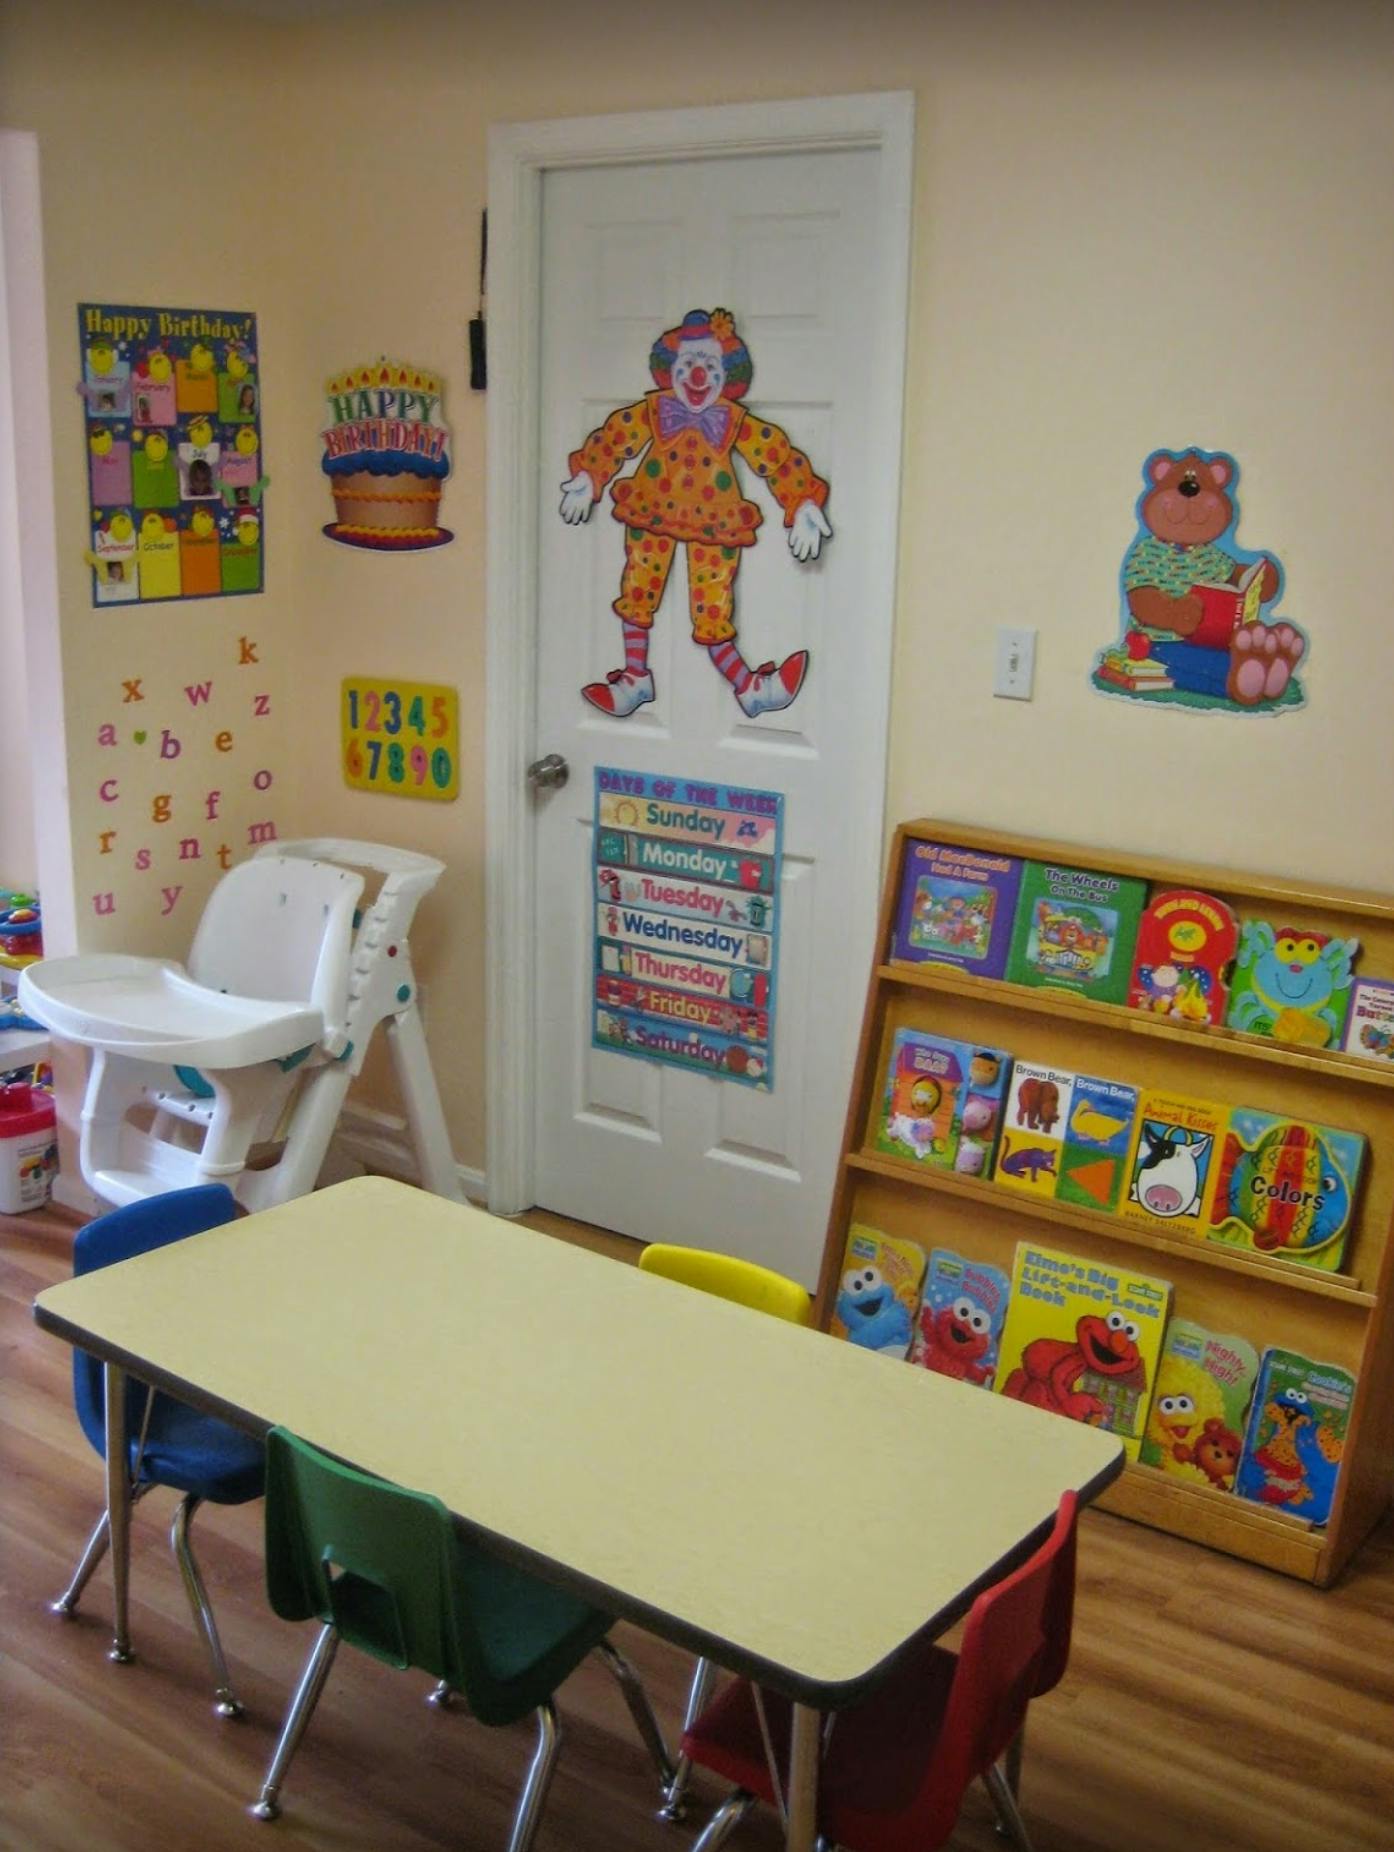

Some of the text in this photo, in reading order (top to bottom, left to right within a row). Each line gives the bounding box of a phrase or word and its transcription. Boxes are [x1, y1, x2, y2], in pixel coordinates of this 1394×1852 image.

[85, 309, 252, 340] Happy Birthday!
[329, 389, 440, 423] HAPPY
[323, 419, 447, 462] BIRTHDAY!
[238, 636, 259, 665] k
[121, 678, 145, 703] x
[184, 680, 213, 706] w
[254, 694, 270, 716] z
[97, 722, 117, 747] a
[160, 730, 181, 759] b
[215, 729, 233, 752] e
[99, 779, 119, 801] c
[253, 769, 273, 790] o
[205, 791, 221, 820] f
[600, 771, 778, 815] DAYS OF THE WEEK
[152, 793, 173, 823] g
[646, 803, 726, 838] Sunday
[99, 829, 117, 854] r
[247, 820, 277, 845] m
[135, 848, 151, 871] s
[179, 837, 202, 859] n
[217, 843, 233, 870] t
[643, 842, 727, 880] Monday
[915, 846, 938, 861] Old
[931, 862, 988, 882] Had A Farm
[1045, 867, 1120, 892] The Wheels
[92, 892, 116, 916] u
[160, 885, 184, 915] y
[641, 879, 725, 918] Tuesday
[1051, 884, 1108, 904] On The Bus
[623, 912, 743, 958] Wednesday
[634, 952, 727, 994] Thursday
[650, 990, 712, 1025] Friday
[636, 1027, 726, 1067] Saturday
[1016, 1064, 1072, 1087] Brown Bear,
[1076, 1078, 1136, 1100] Brown Bear,
[1144, 1102, 1183, 1123] Animal
[1250, 1176, 1326, 1212] Colors
[1025, 1251, 1119, 1292] Elmo's Big
[1019, 1281, 1067, 1307] Book
